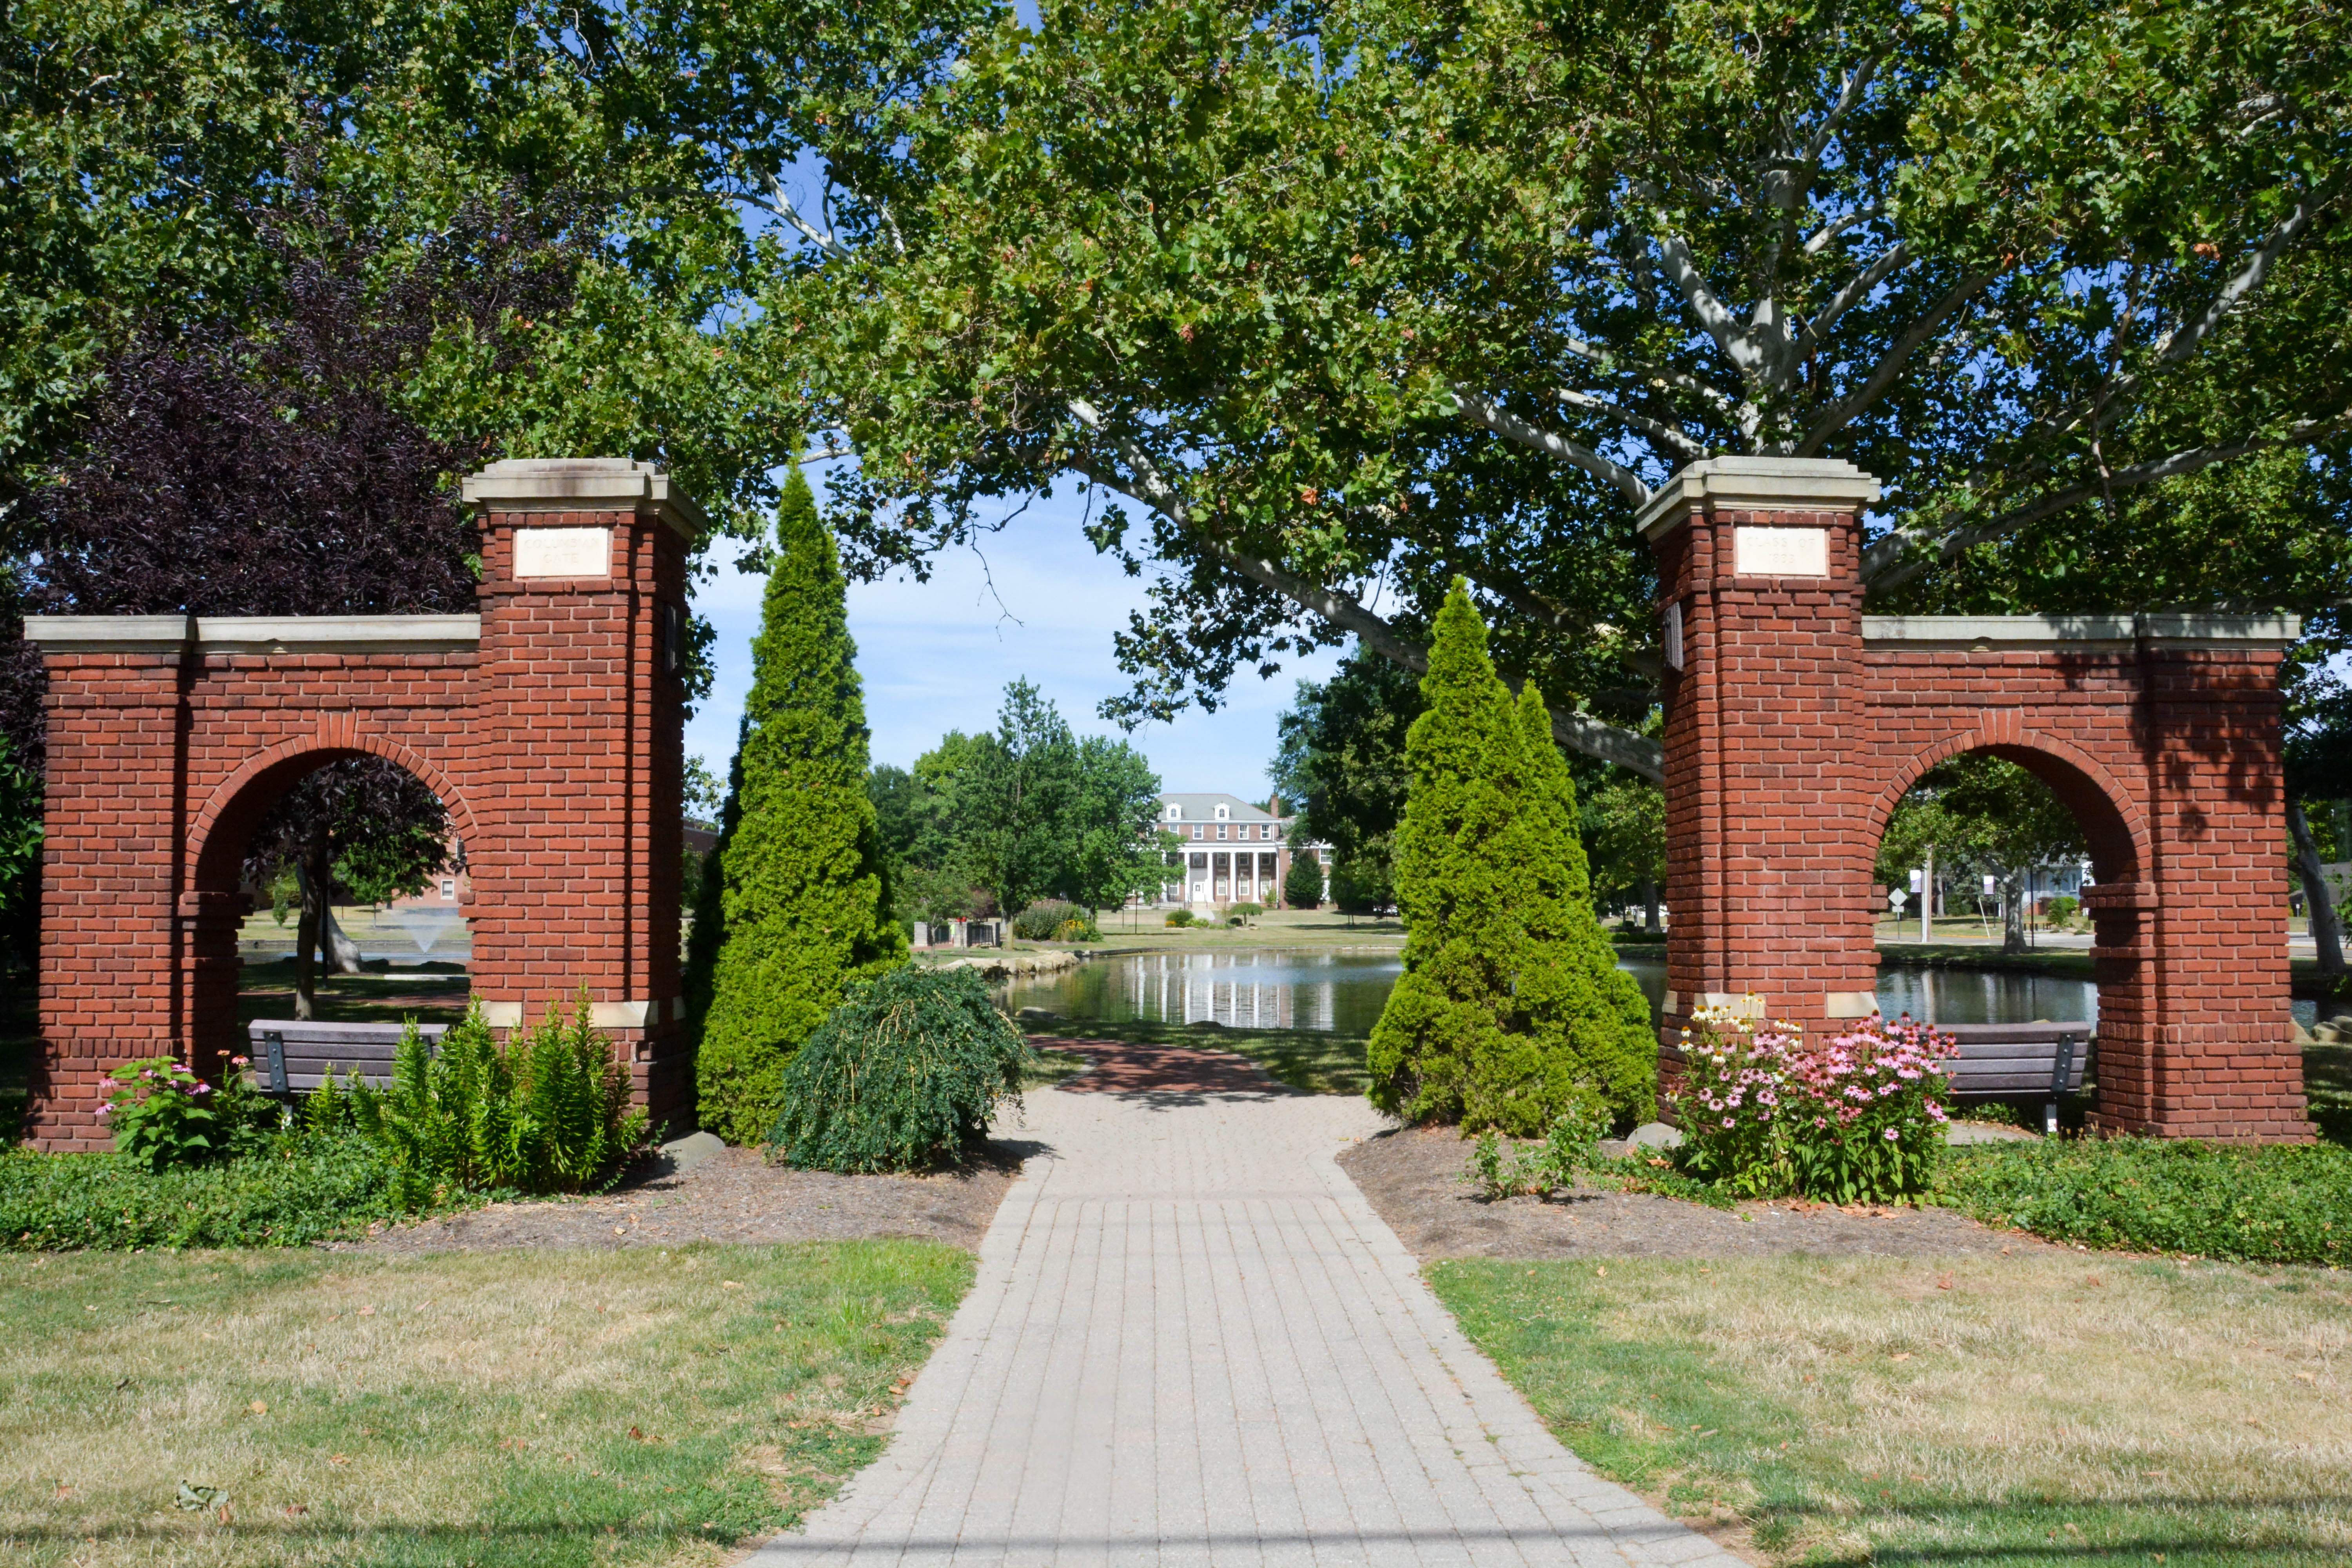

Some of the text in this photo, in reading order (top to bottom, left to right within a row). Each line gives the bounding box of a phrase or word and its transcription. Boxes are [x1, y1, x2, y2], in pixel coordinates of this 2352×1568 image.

[524, 538, 600, 549] COLUMBIAN
[1746, 537, 1816, 548] CLASS OF
[543, 553, 579, 564] GATE
